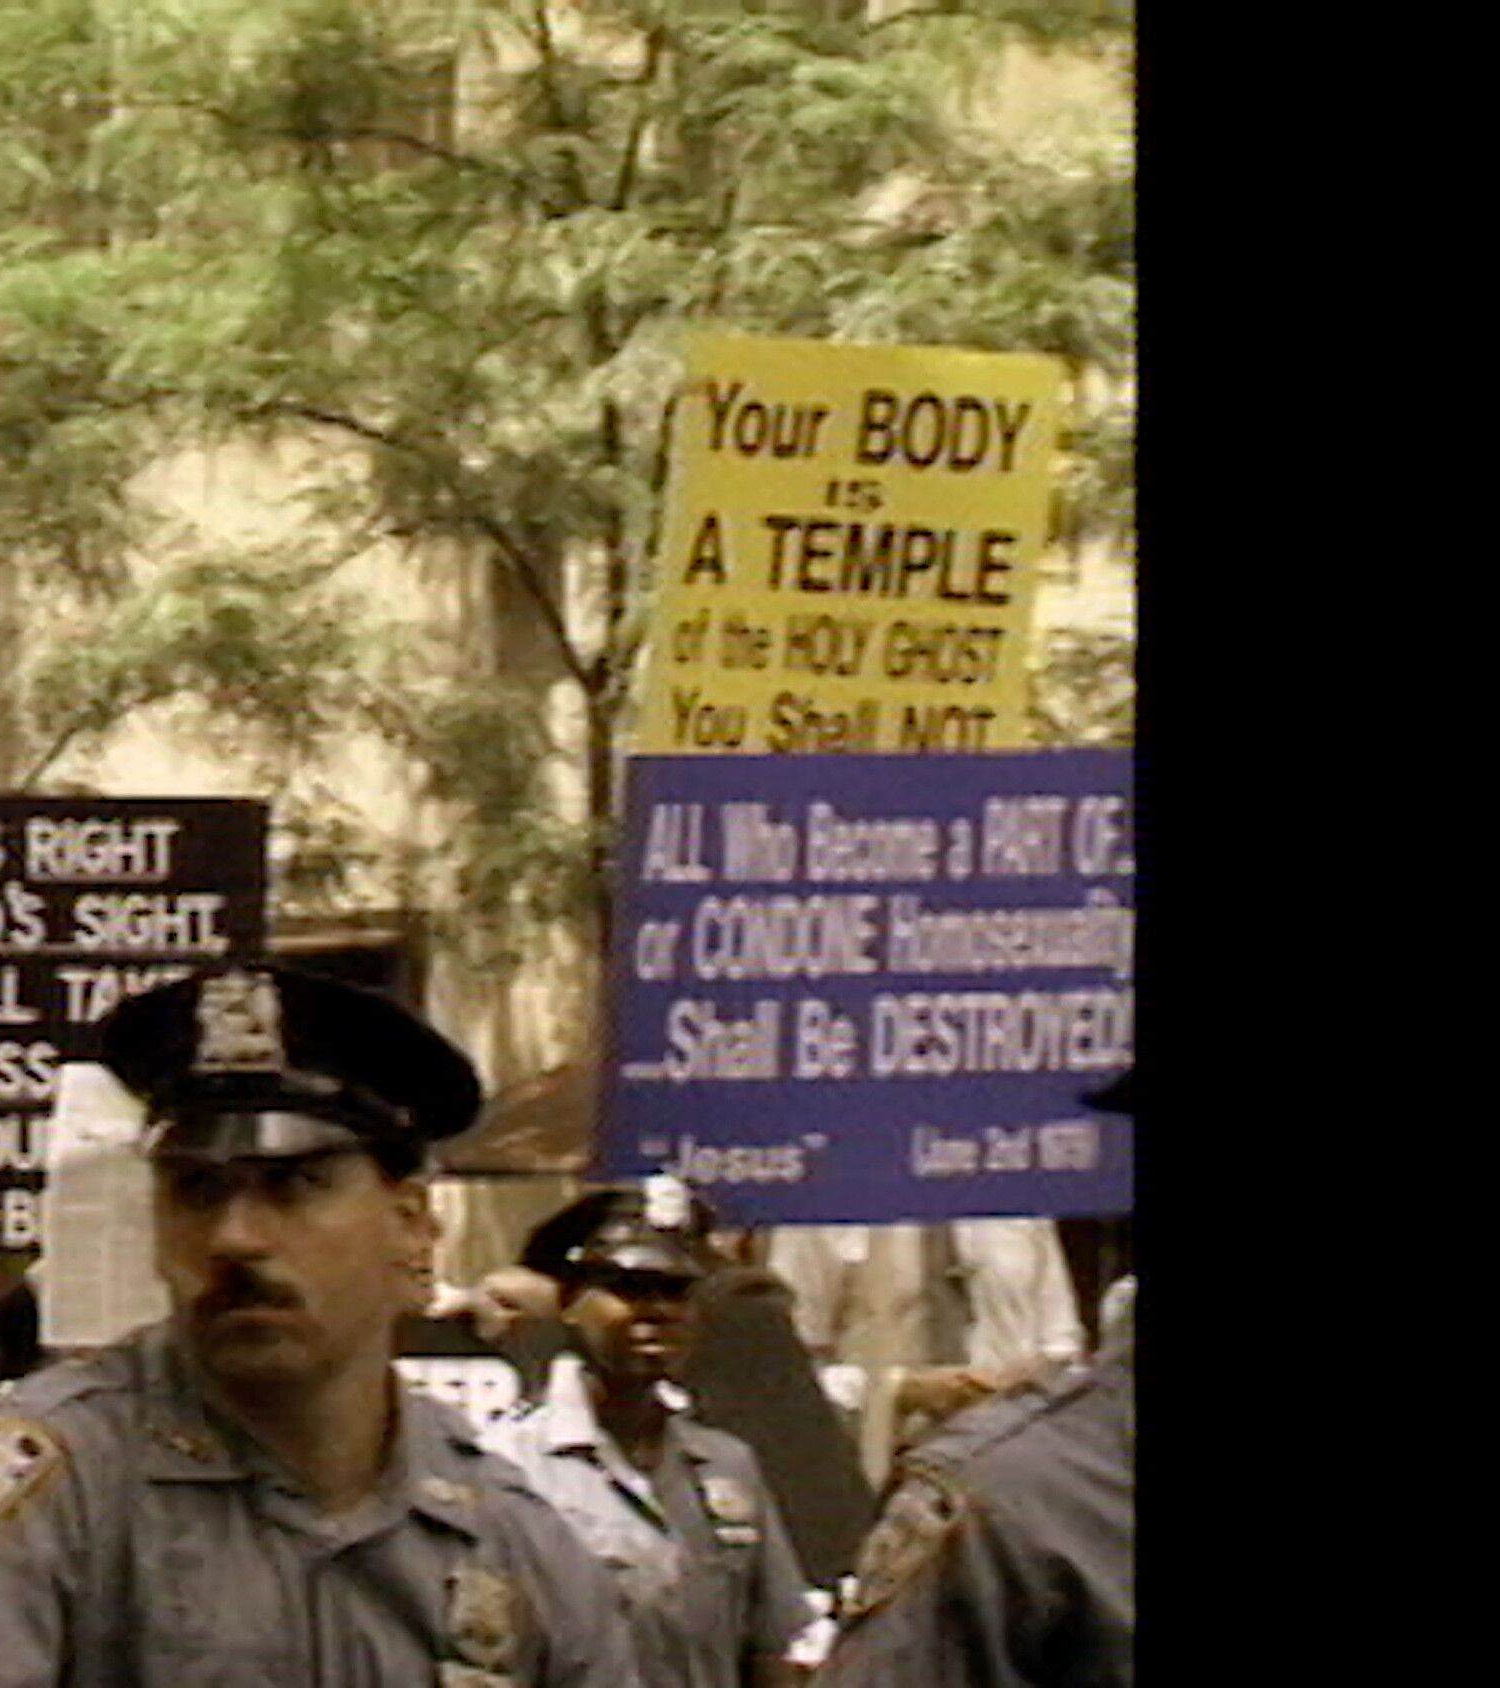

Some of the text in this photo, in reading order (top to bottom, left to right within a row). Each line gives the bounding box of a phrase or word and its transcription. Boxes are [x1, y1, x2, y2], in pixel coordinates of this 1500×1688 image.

[857, 387, 1032, 473] BODY
[684, 510, 1022, 606] A TEMPLE
[674, 607, 713, 664] of
[784, 614, 871, 676] HOLY
[884, 620, 1004, 684] GHOST
[671, 685, 997, 754] You Shall NOT
[25, 819, 179, 880] RIGHT
[641, 802, 712, 882] ALL
[721, 802, 798, 882] Who
[806, 801, 943, 883] Become
[946, 816, 974, 881] a
[981, 796, 1067, 876] PART
[635, 921, 680, 981] or
[693, 894, 880, 980] CONDONE
[794, 998, 858, 1080] Be
